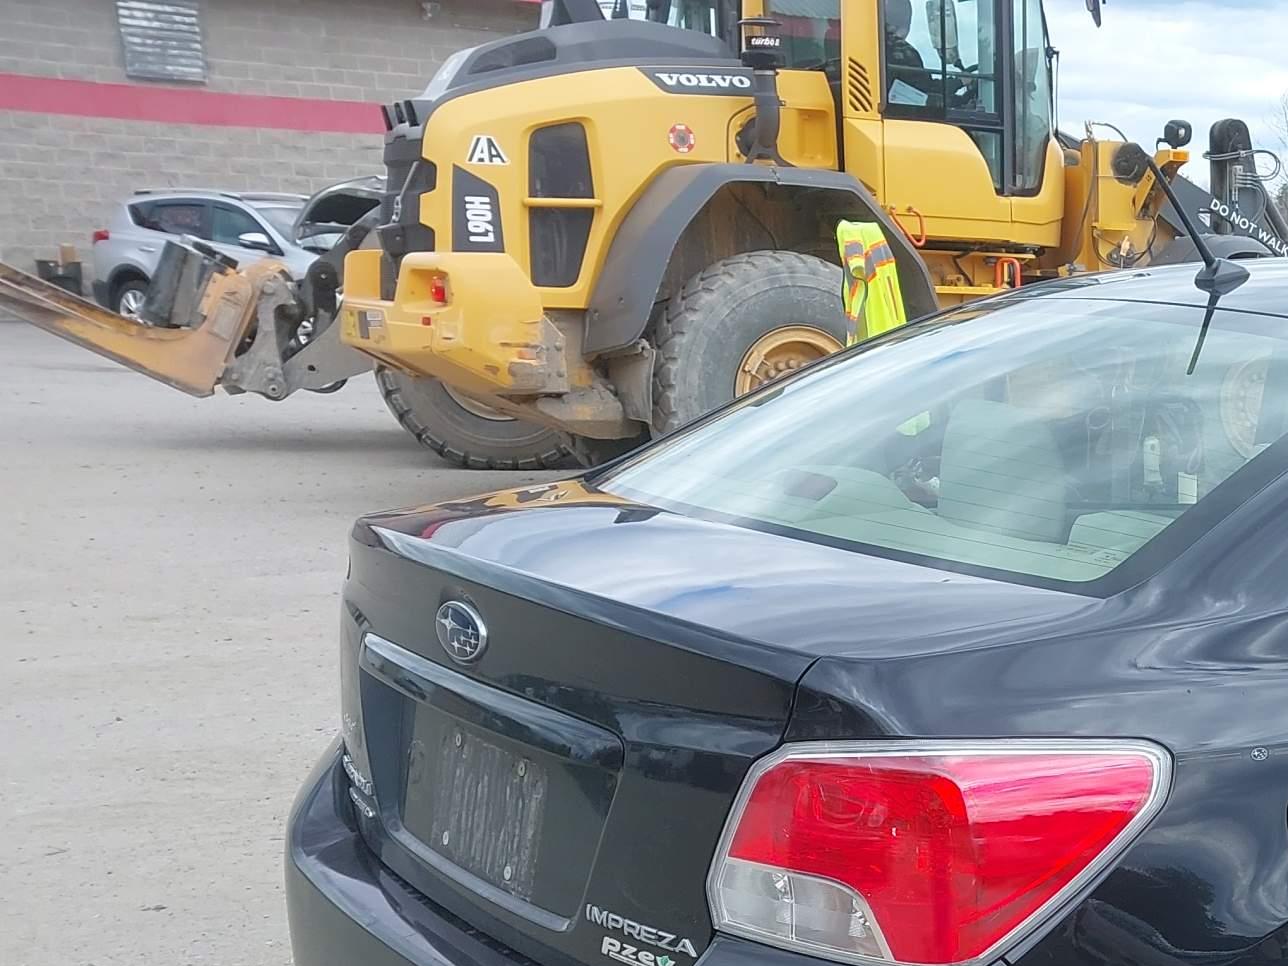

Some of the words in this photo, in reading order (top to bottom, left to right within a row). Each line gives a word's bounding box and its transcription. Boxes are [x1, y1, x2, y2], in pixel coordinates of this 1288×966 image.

[655, 73, 751, 88] VOLVO
[464, 196, 495, 242] L90H
[1210, 199, 1229, 216] DO
[1229, 211, 1257, 233] NOT
[586, 903, 698, 958] IMPREZA
